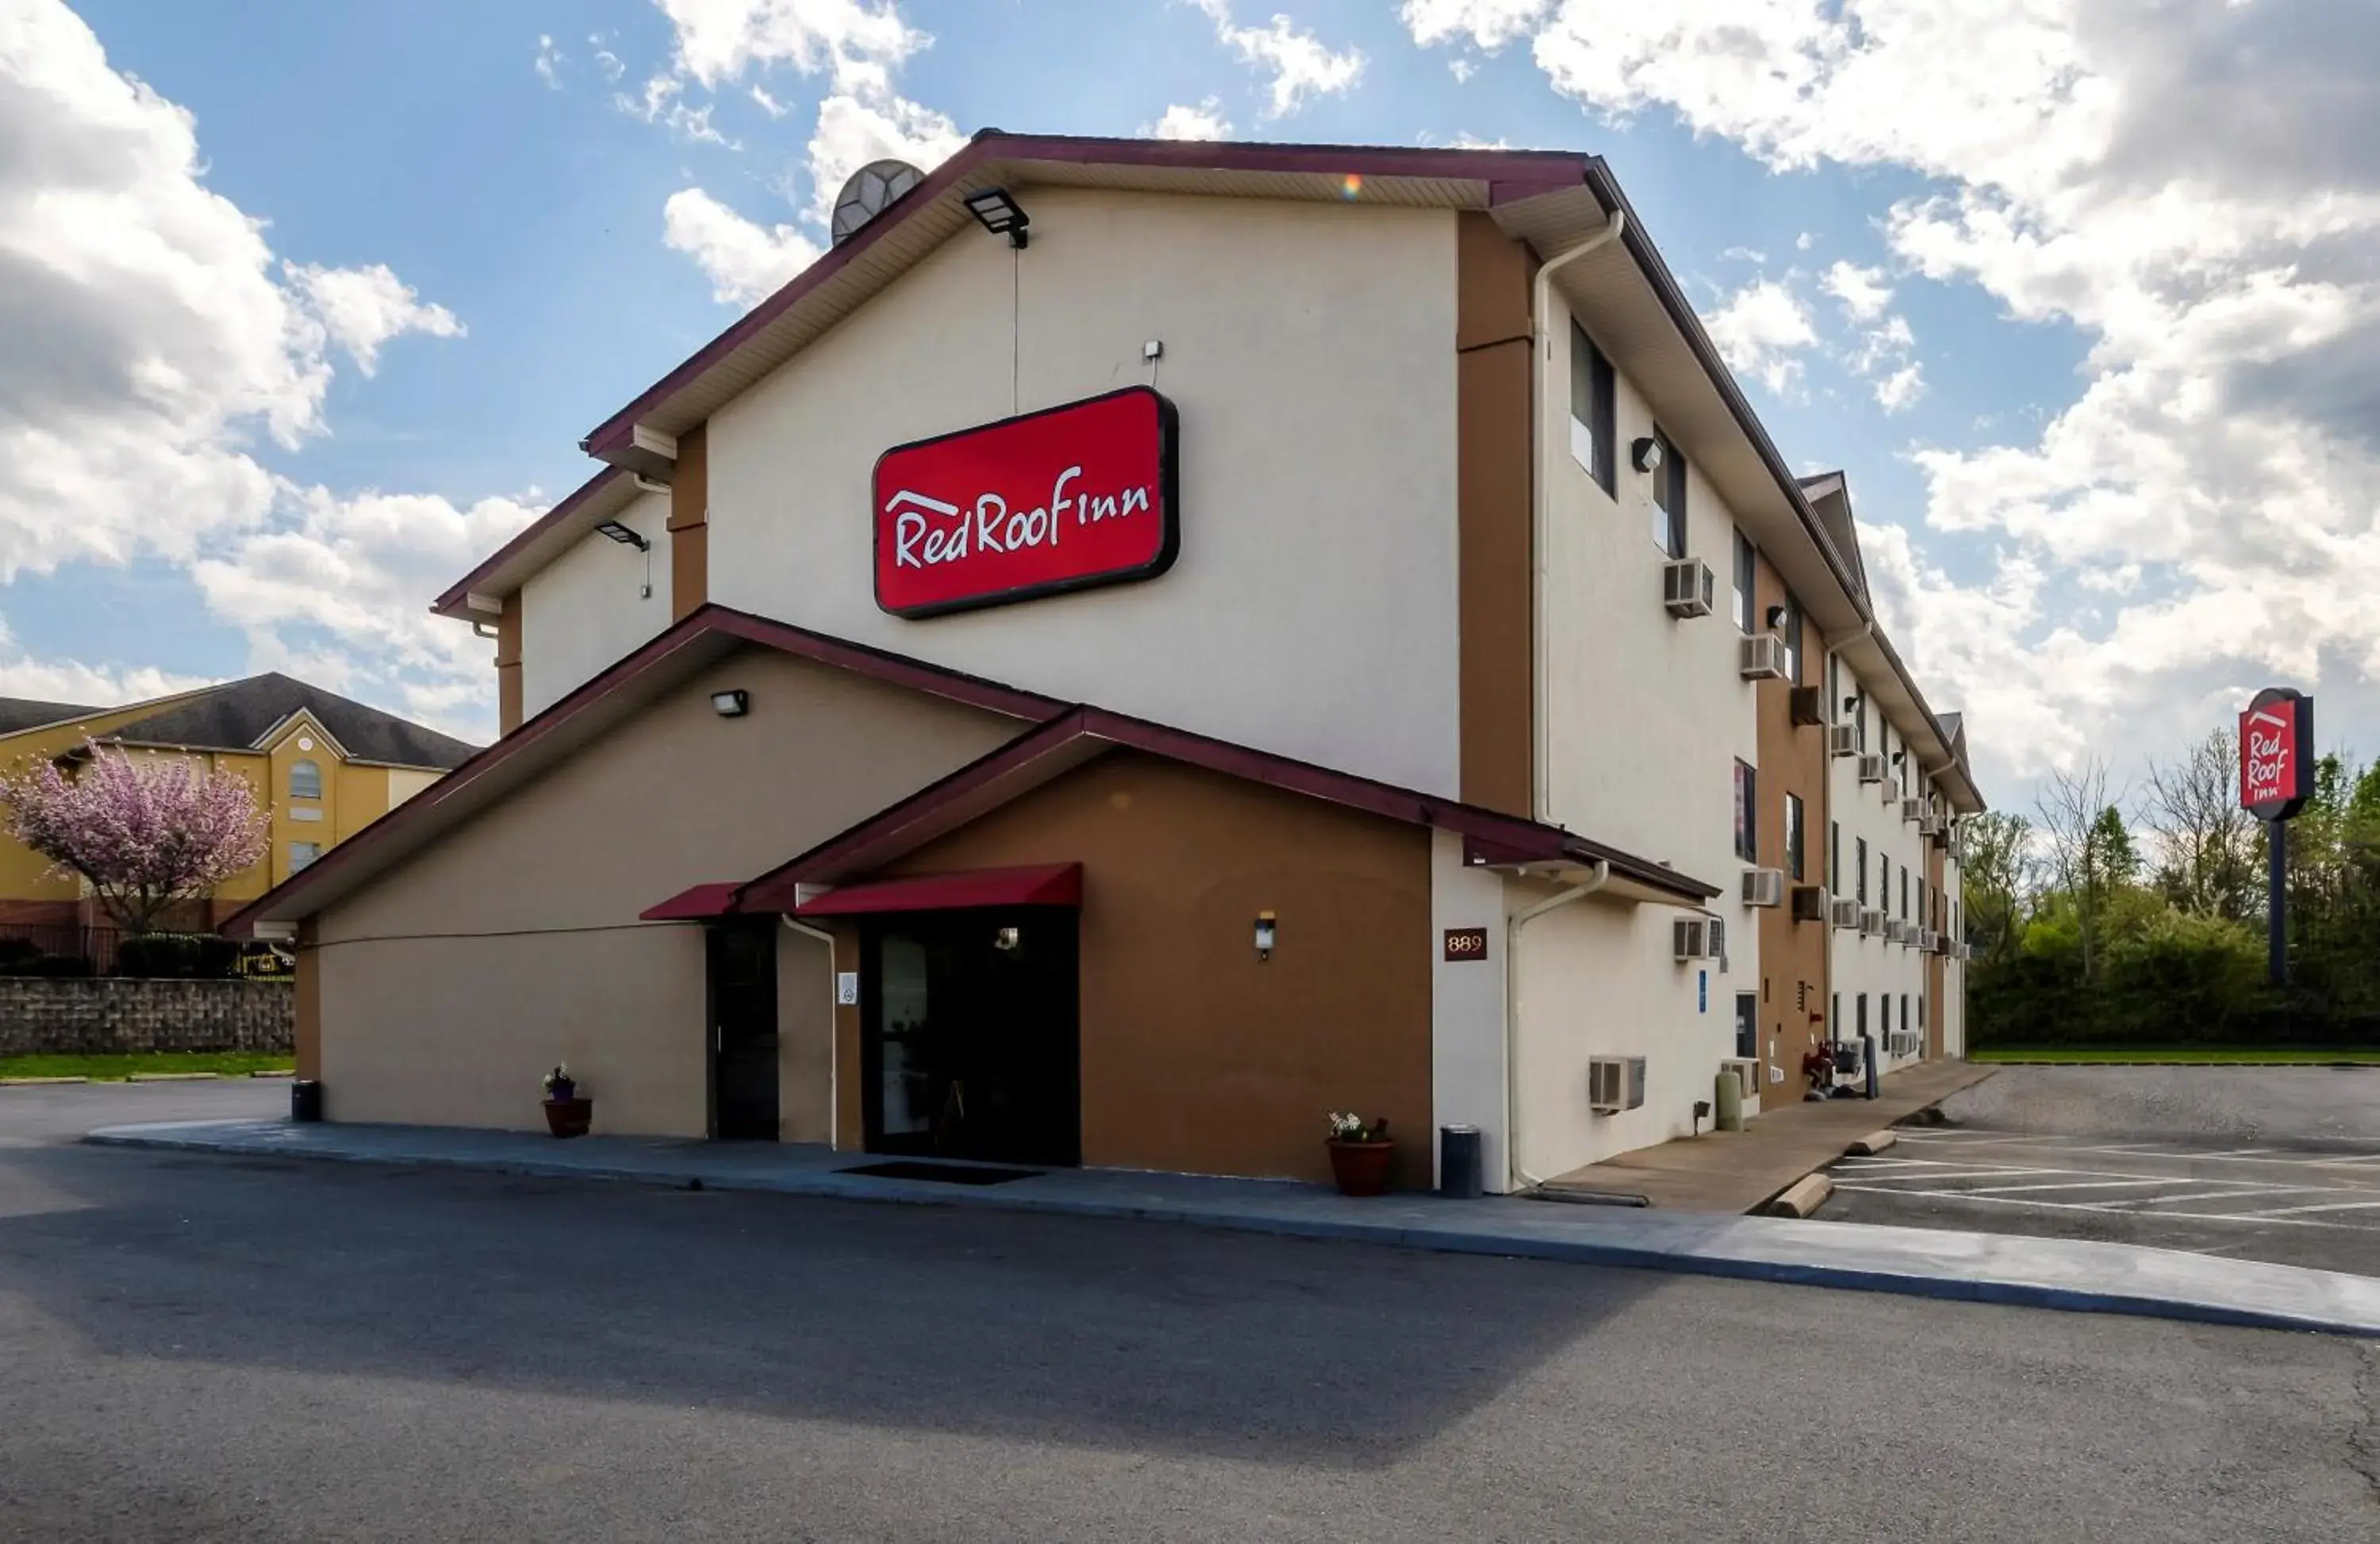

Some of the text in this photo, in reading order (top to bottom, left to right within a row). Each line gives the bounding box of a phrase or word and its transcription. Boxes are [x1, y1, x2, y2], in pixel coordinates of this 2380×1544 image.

[896, 510, 971, 569] Red
[977, 466, 1081, 554] Roof
[2250, 730, 2281, 759] Red
[2248, 748, 2289, 789] Roof
[1448, 935, 1482, 952] 889
